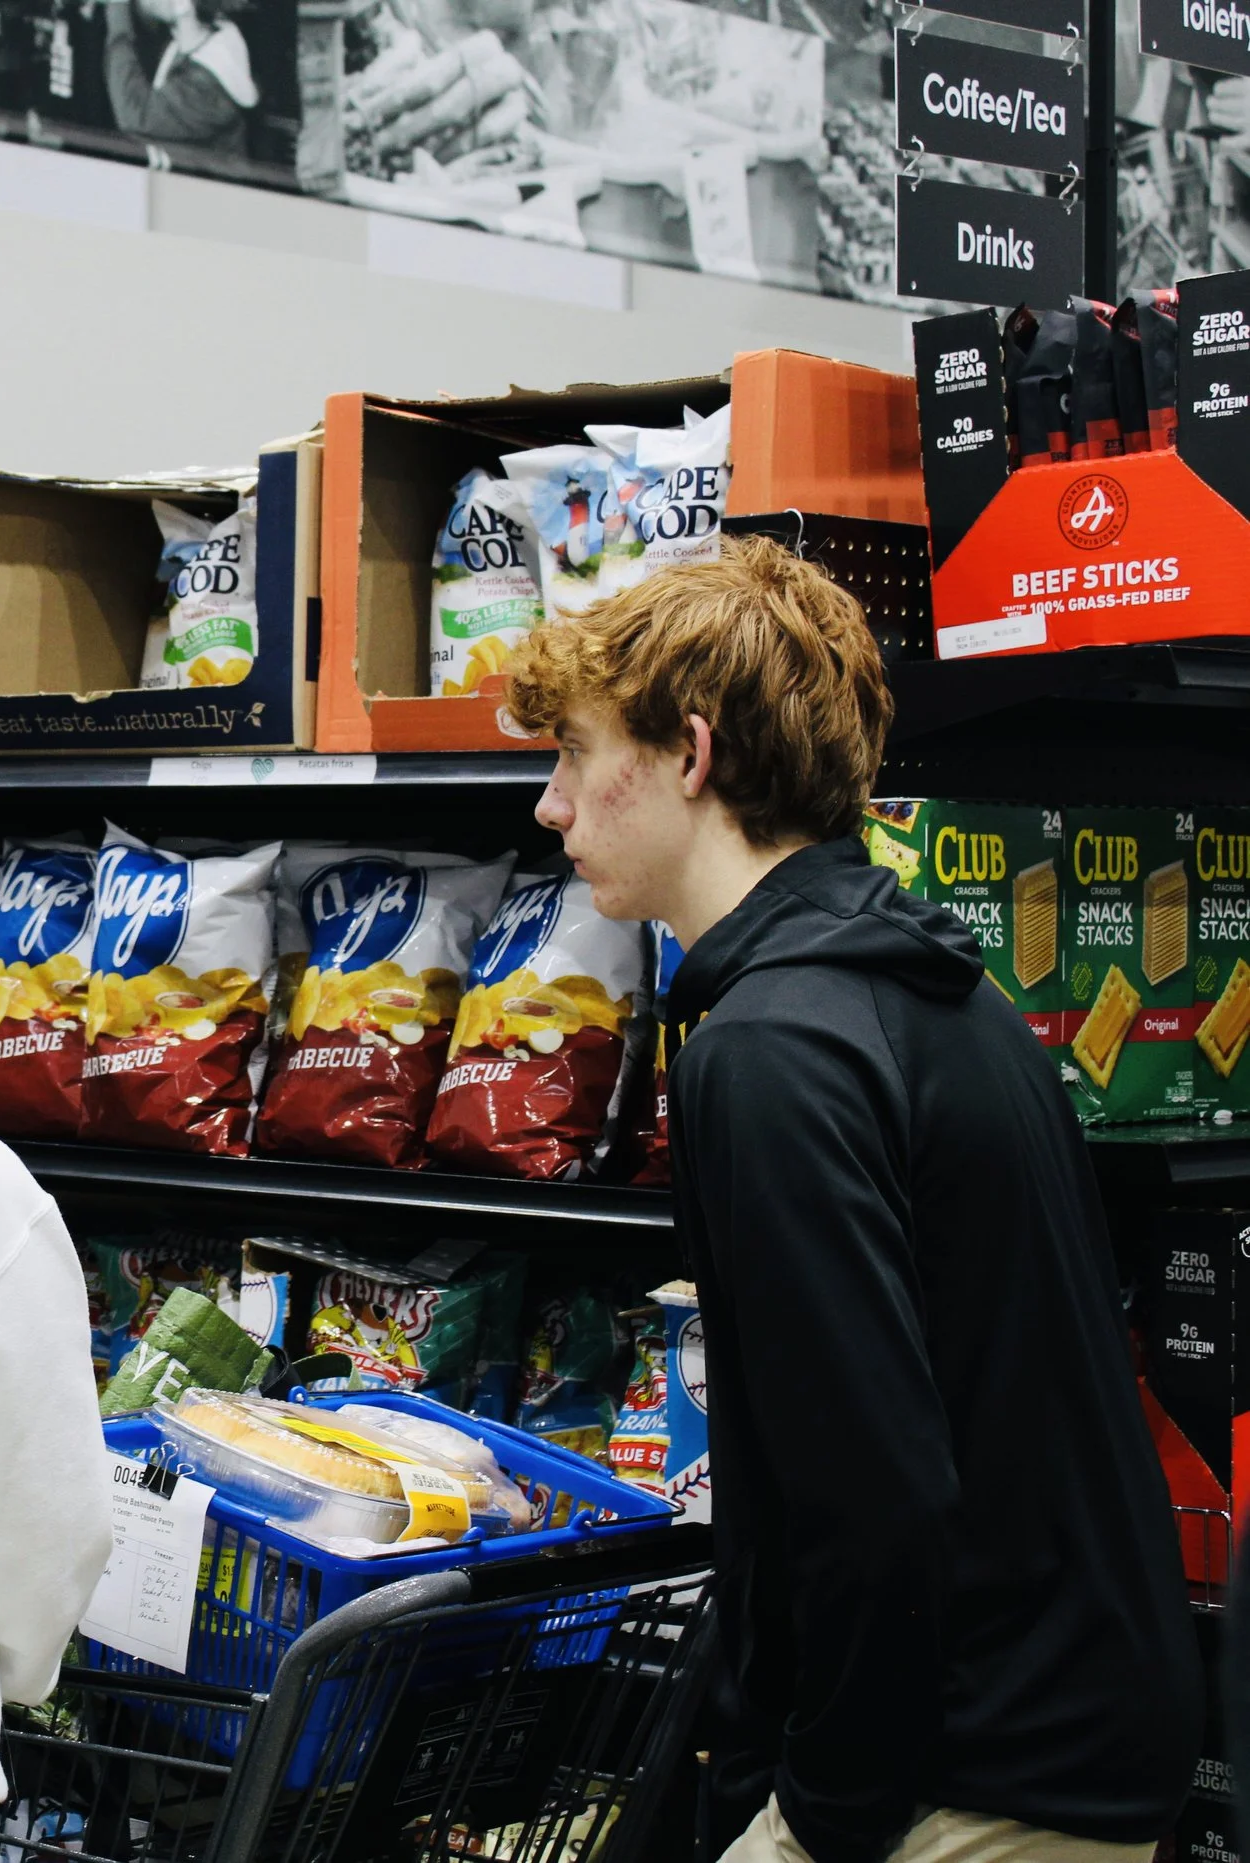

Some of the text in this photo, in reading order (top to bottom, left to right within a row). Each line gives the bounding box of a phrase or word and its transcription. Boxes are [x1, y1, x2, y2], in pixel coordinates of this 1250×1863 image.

[923, 73, 1066, 135] Coffee/Tea
[957, 222, 1034, 271] Drinks
[1200, 311, 1243, 330] ZERO
[1192, 325, 1250, 346] SUGAR
[940, 348, 979, 368] ZERO
[934, 362, 987, 384] SUGAR
[1210, 383, 1230, 398] 9G
[1193, 396, 1248, 413] PROTEIN
[953, 417, 972, 433] 90
[937, 429, 994, 449] CALORIES
[1063, 479, 1124, 514] COUNTRY ARCHER
[639, 505, 718, 544] COD
[1068, 524, 1119, 545] PROVISIONS
[174, 565, 239, 598] COD
[1012, 557, 1179, 598] BEEF STICKS
[484, 601, 510, 618] LESS
[1002, 604, 1026, 612] CRAFTED
[1030, 587, 1190, 615] 100% GRASS-FED BEEF
[191, 760, 213, 771] Chips
[298, 759, 354, 769] Patatas fritas
[1042, 810, 1062, 831] 24
[1175, 813, 1194, 833] 24
[935, 826, 1006, 885] CLUB
[1074, 829, 1138, 885] CLUB
[954, 887, 989, 896] CRACKERS
[1090, 887, 1121, 895] CRACKERS
[1213, 884, 1244, 892] CRACKERS
[94, 847, 182, 968] Jays
[1078, 902, 1133, 923] SNACK
[972, 927, 1004, 948] CKS
[1076, 926, 1134, 946] STACKS
[1199, 921, 1250, 940] STACK
[1144, 1018, 1179, 1035] Original
[1172, 1250, 1209, 1267] ZERO
[1165, 1266, 1215, 1284] SUGAR
[1180, 1323, 1198, 1338] 9G
[1166, 1338, 1214, 1354] PROTEIN
[1196, 1758, 1234, 1777] ZERO
[1206, 1830, 1224, 1847] 9G
